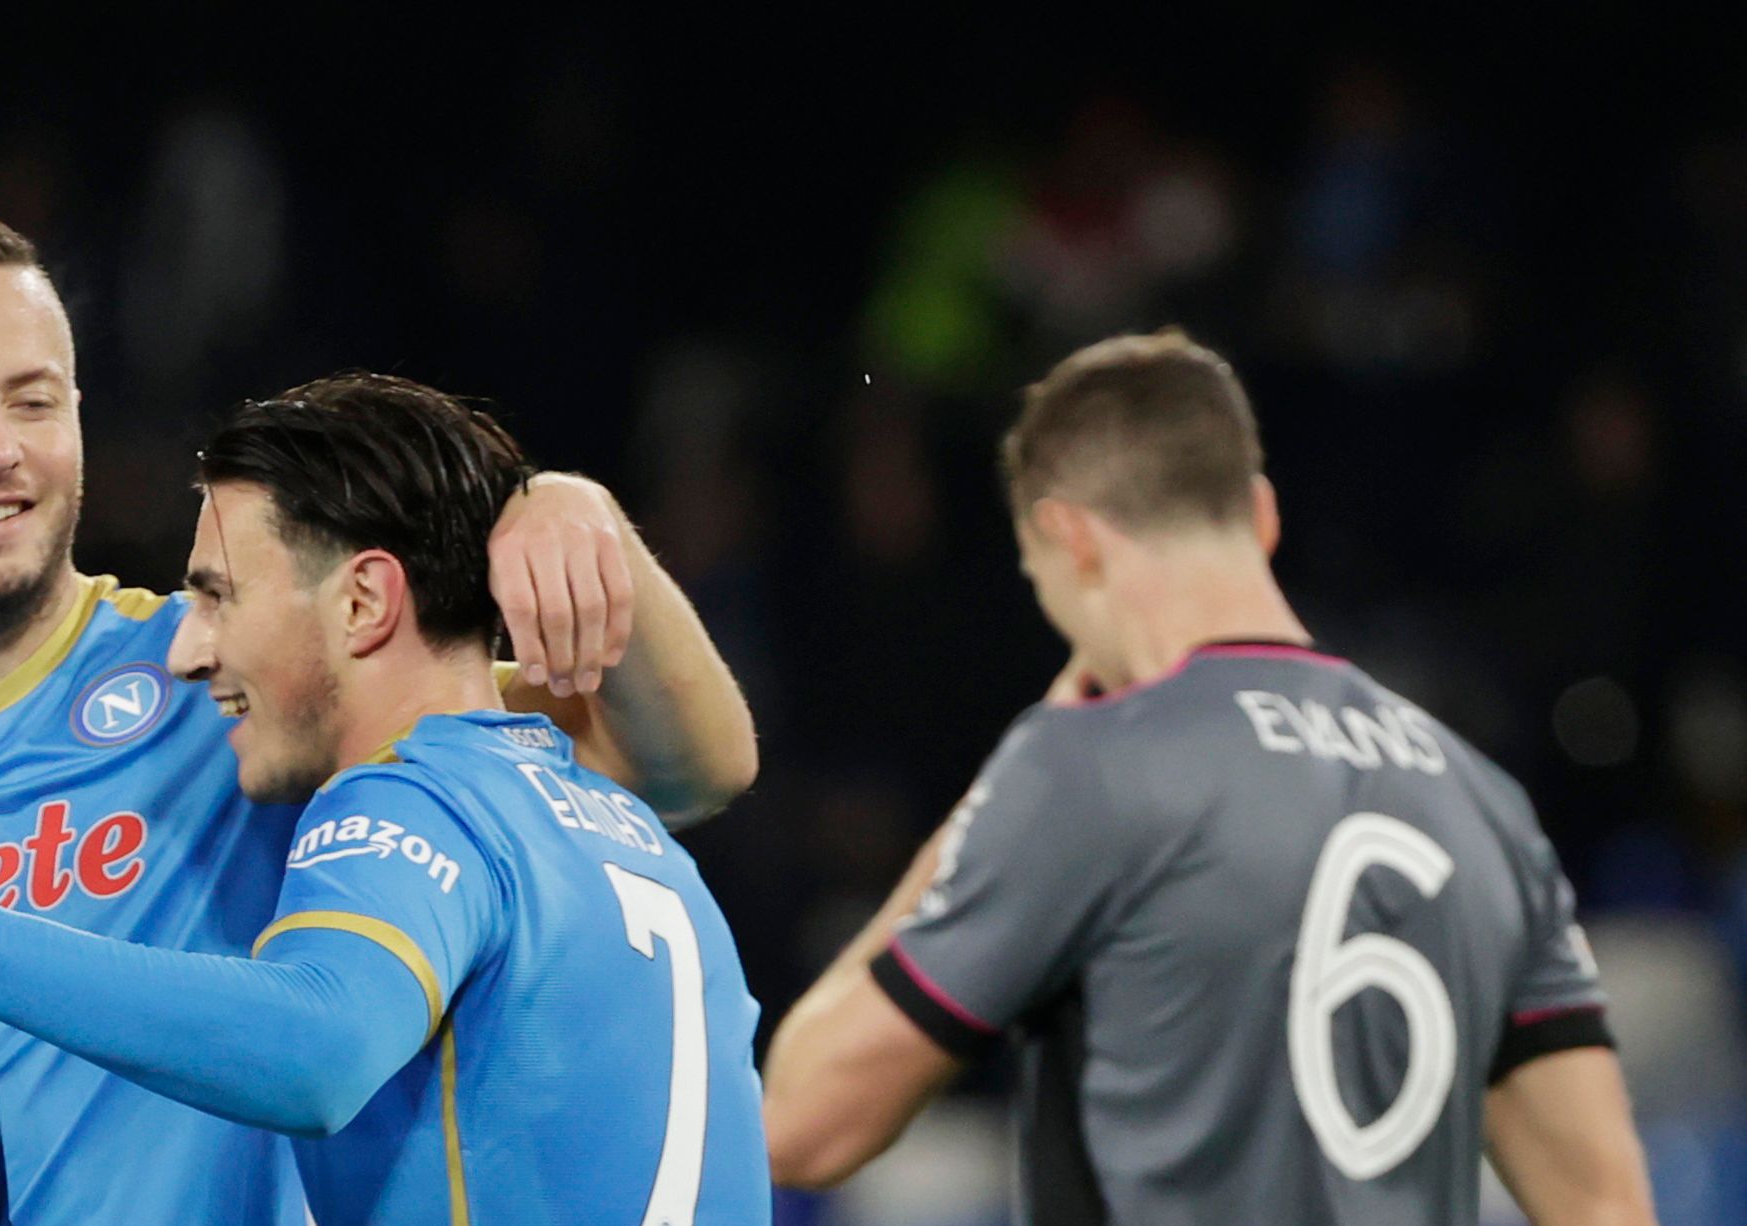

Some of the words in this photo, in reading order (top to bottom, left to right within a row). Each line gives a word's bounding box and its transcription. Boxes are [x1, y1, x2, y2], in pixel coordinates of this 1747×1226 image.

[1234, 689, 1446, 776] EVANS
[287, 815, 461, 895] mazon
[1287, 811, 1457, 1182] 6
